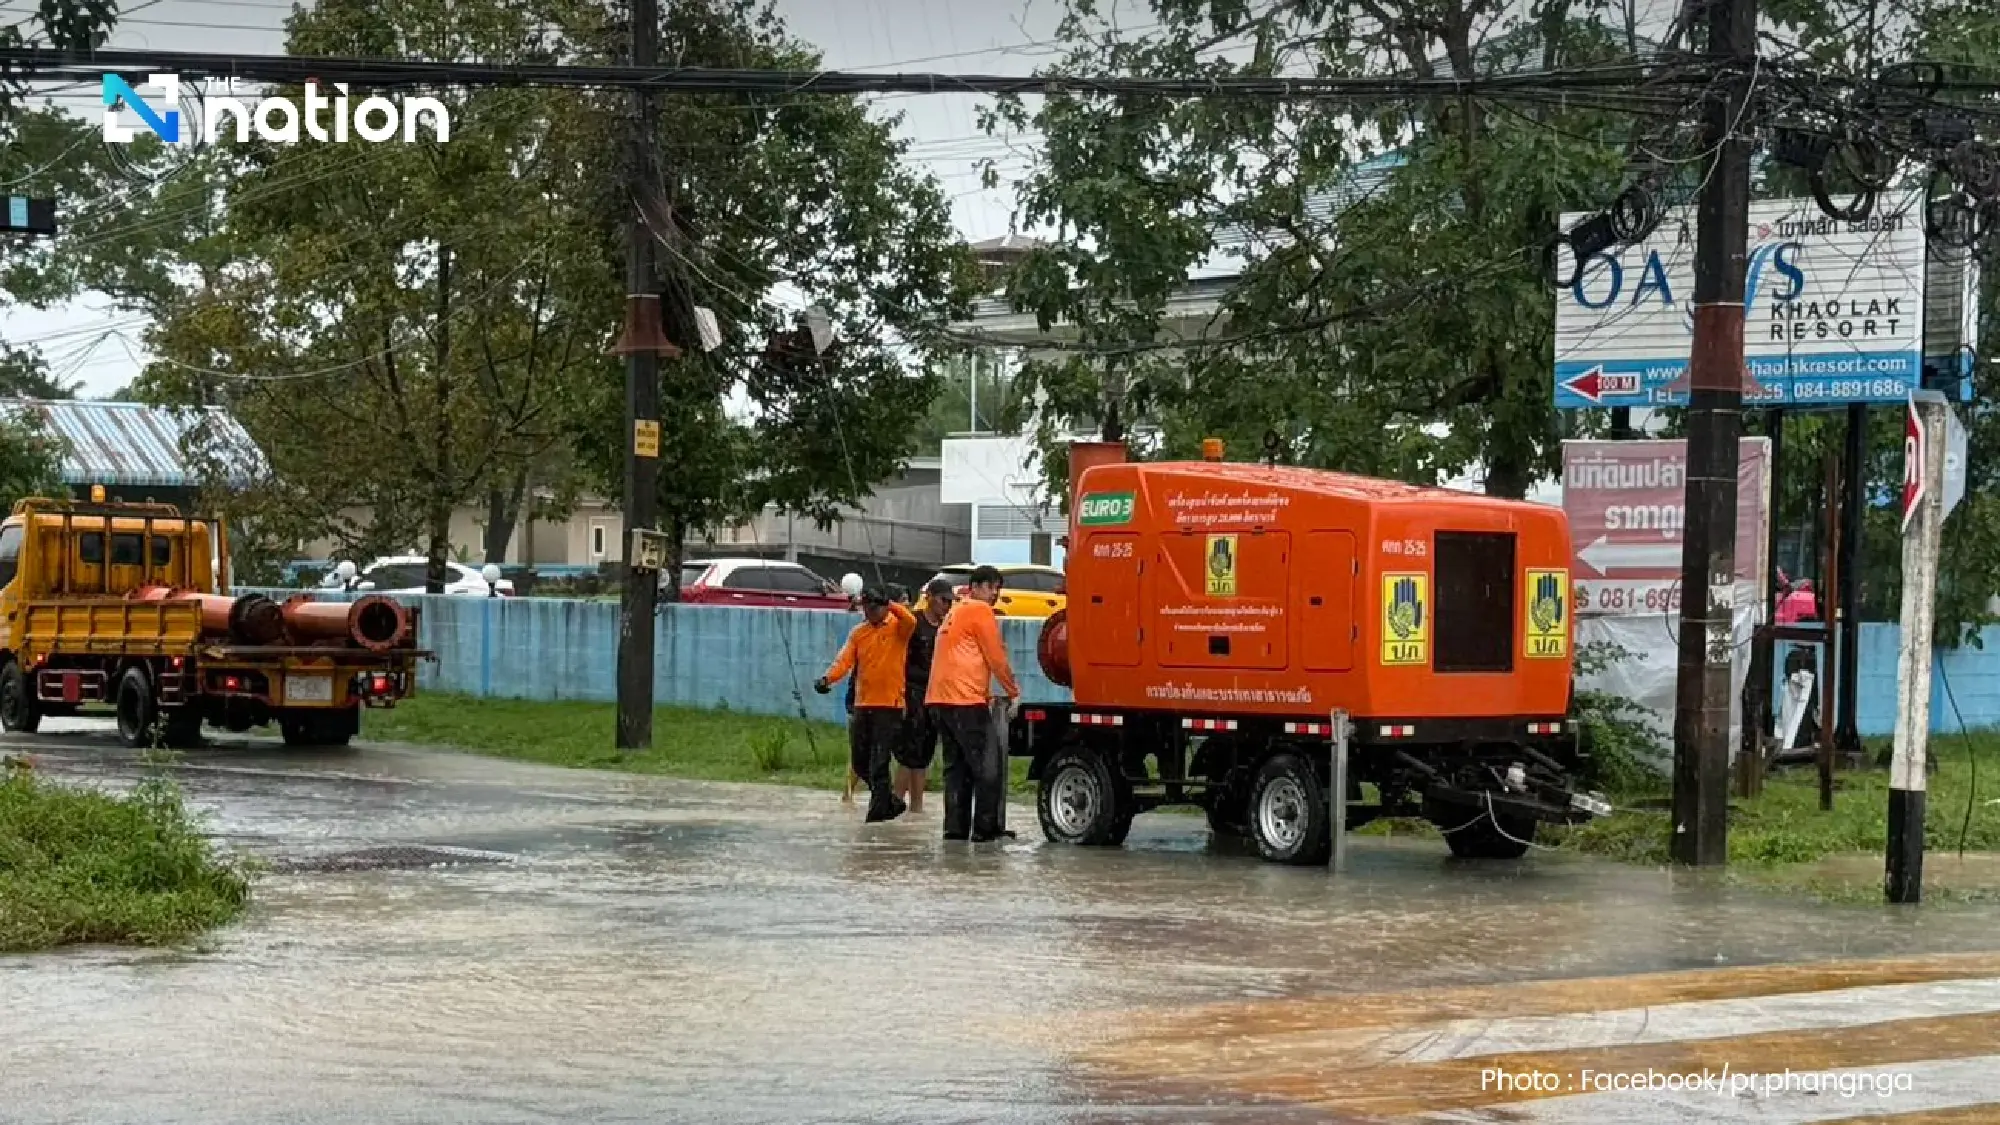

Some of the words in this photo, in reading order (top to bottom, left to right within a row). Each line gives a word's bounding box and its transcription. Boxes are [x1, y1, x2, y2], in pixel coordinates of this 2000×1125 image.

[1771, 300, 1840, 320] KHAO
[1851, 298, 1900, 316] LAK
[1771, 319, 1900, 340] RESORT
[1794, 379, 1904, 398] 084-8891686
[1081, 499, 1120, 517] EURO
[1121, 499, 1133, 515] 3
[1599, 587, 1683, 609] 081-695
